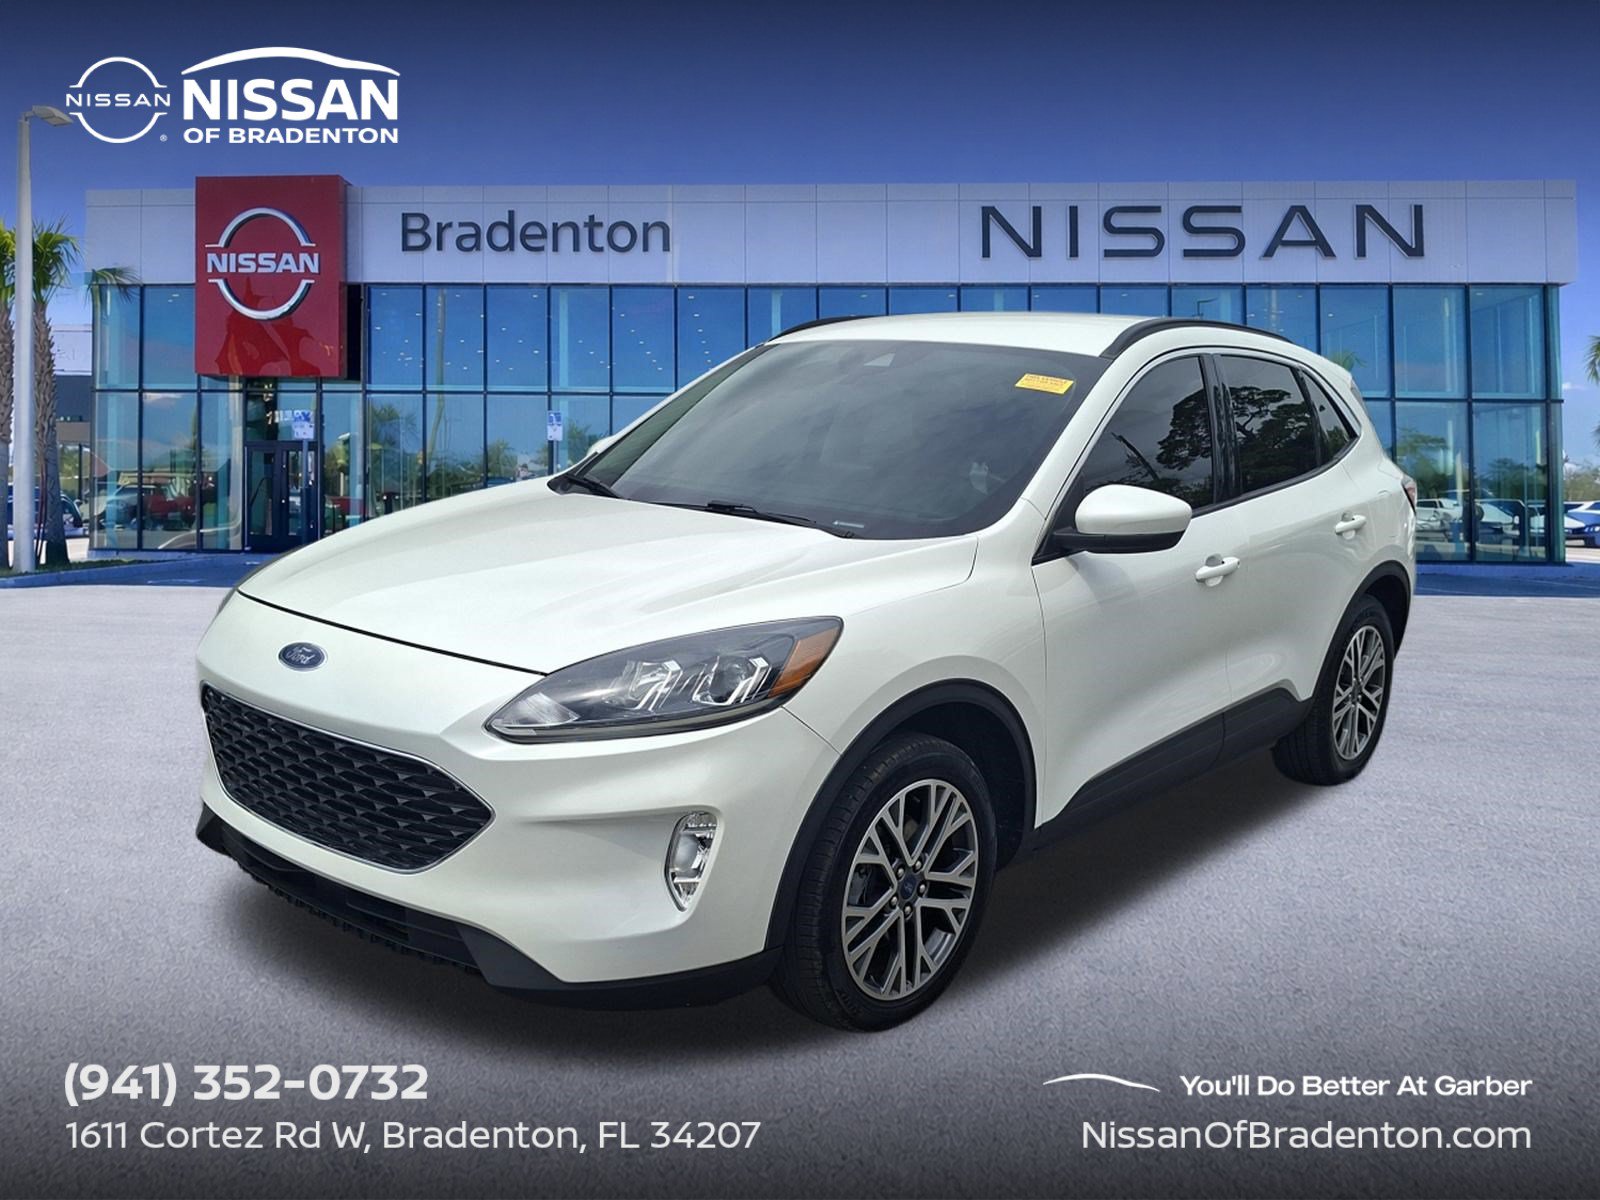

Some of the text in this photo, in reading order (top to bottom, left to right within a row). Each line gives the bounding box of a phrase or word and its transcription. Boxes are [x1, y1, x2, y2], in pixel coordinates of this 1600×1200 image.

[401, 210, 671, 254] Bradenton
[981, 204, 1424, 258] NISSAN
[207, 252, 319, 274] NISSAN
[285, 646, 316, 665] Ford
